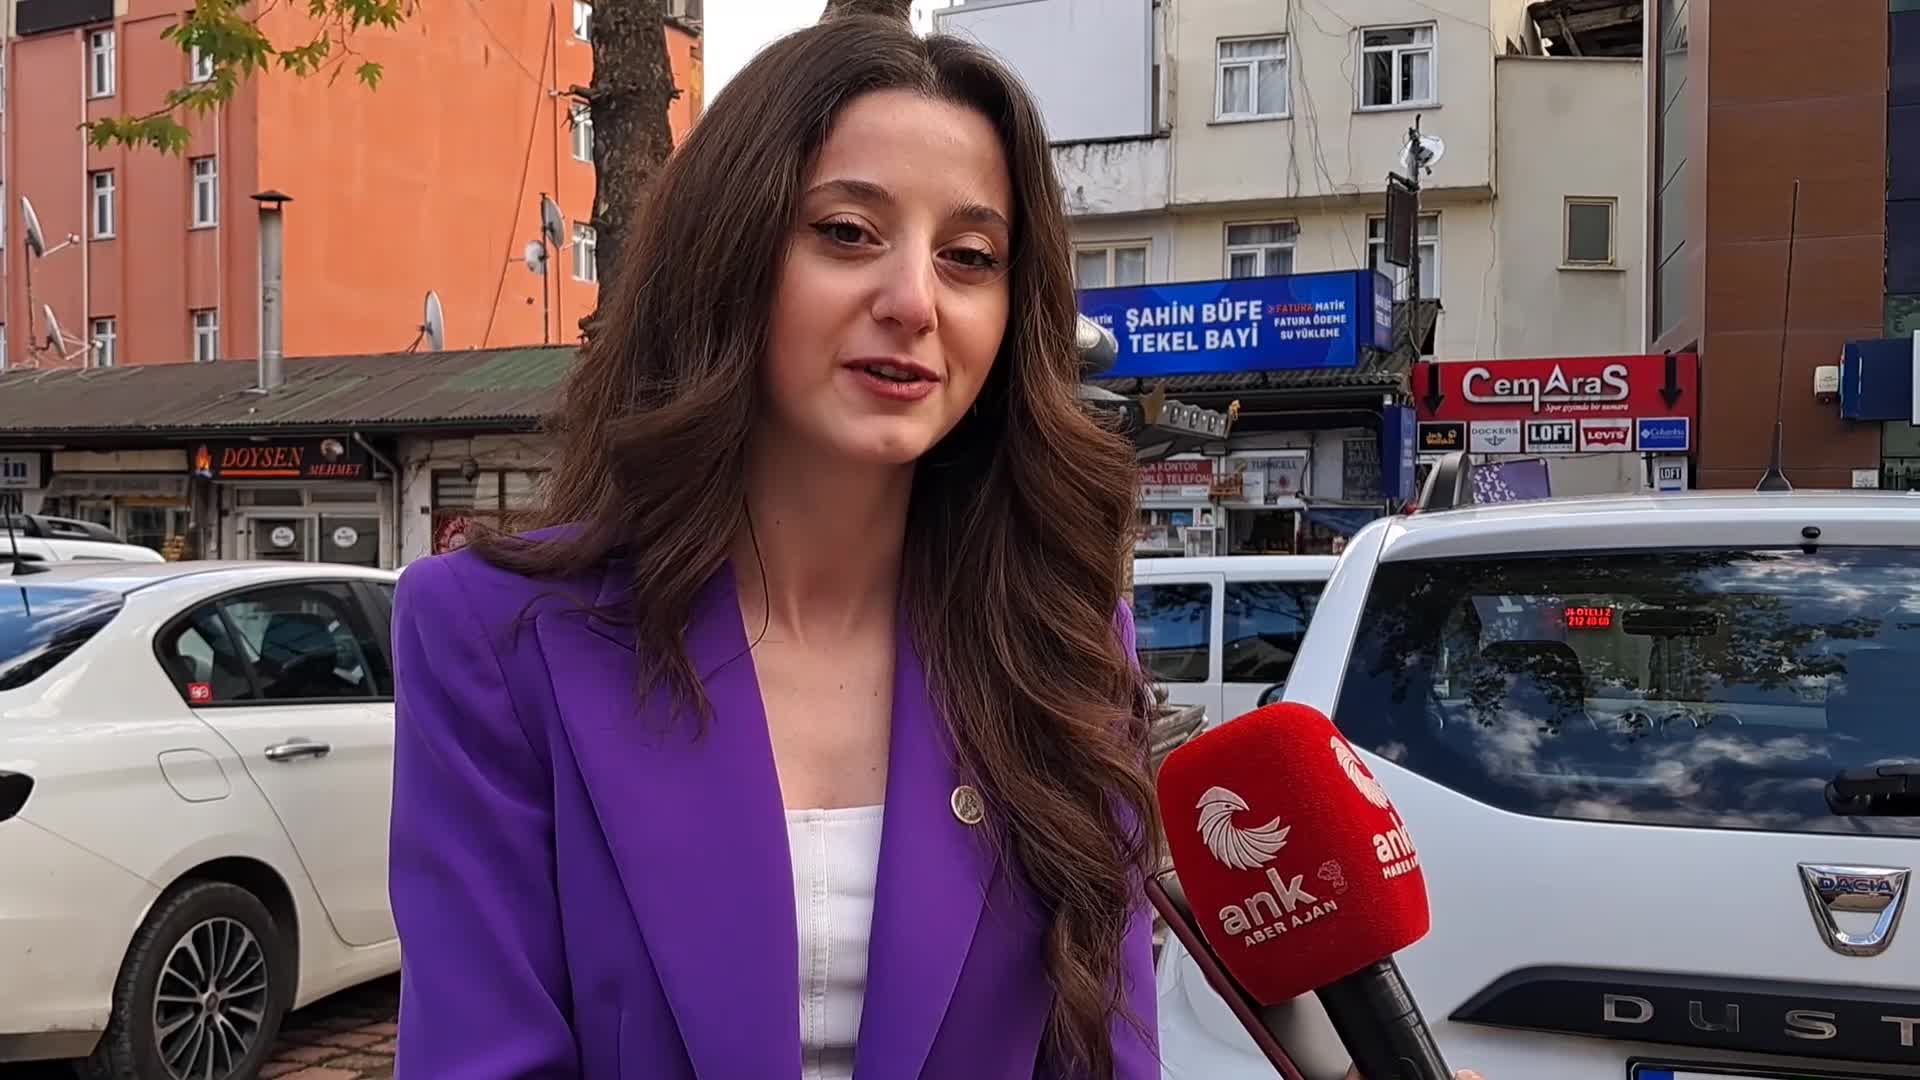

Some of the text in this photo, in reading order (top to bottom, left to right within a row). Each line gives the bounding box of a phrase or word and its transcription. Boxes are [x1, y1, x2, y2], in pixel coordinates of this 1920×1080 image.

[1125, 297, 1262, 333] ŞAHİN BÜFE
[1274, 314, 1347, 328] FATURA ÖDEME
[1128, 321, 1258, 353] TEKEL BAYİ
[1280, 327, 1340, 340] SU YÜKLEME
[1471, 427, 1519, 435] DOCKERS
[1530, 425, 1572, 441] LOFT
[222, 447, 304, 467] DOYSEN
[309, 464, 361, 476] MEHMET
[1660, 468, 1681, 480] LOFT
[1818, 876, 1893, 892] DACIA
[1218, 867, 1318, 936] ank
[1291, 899, 1339, 925] AJAN
